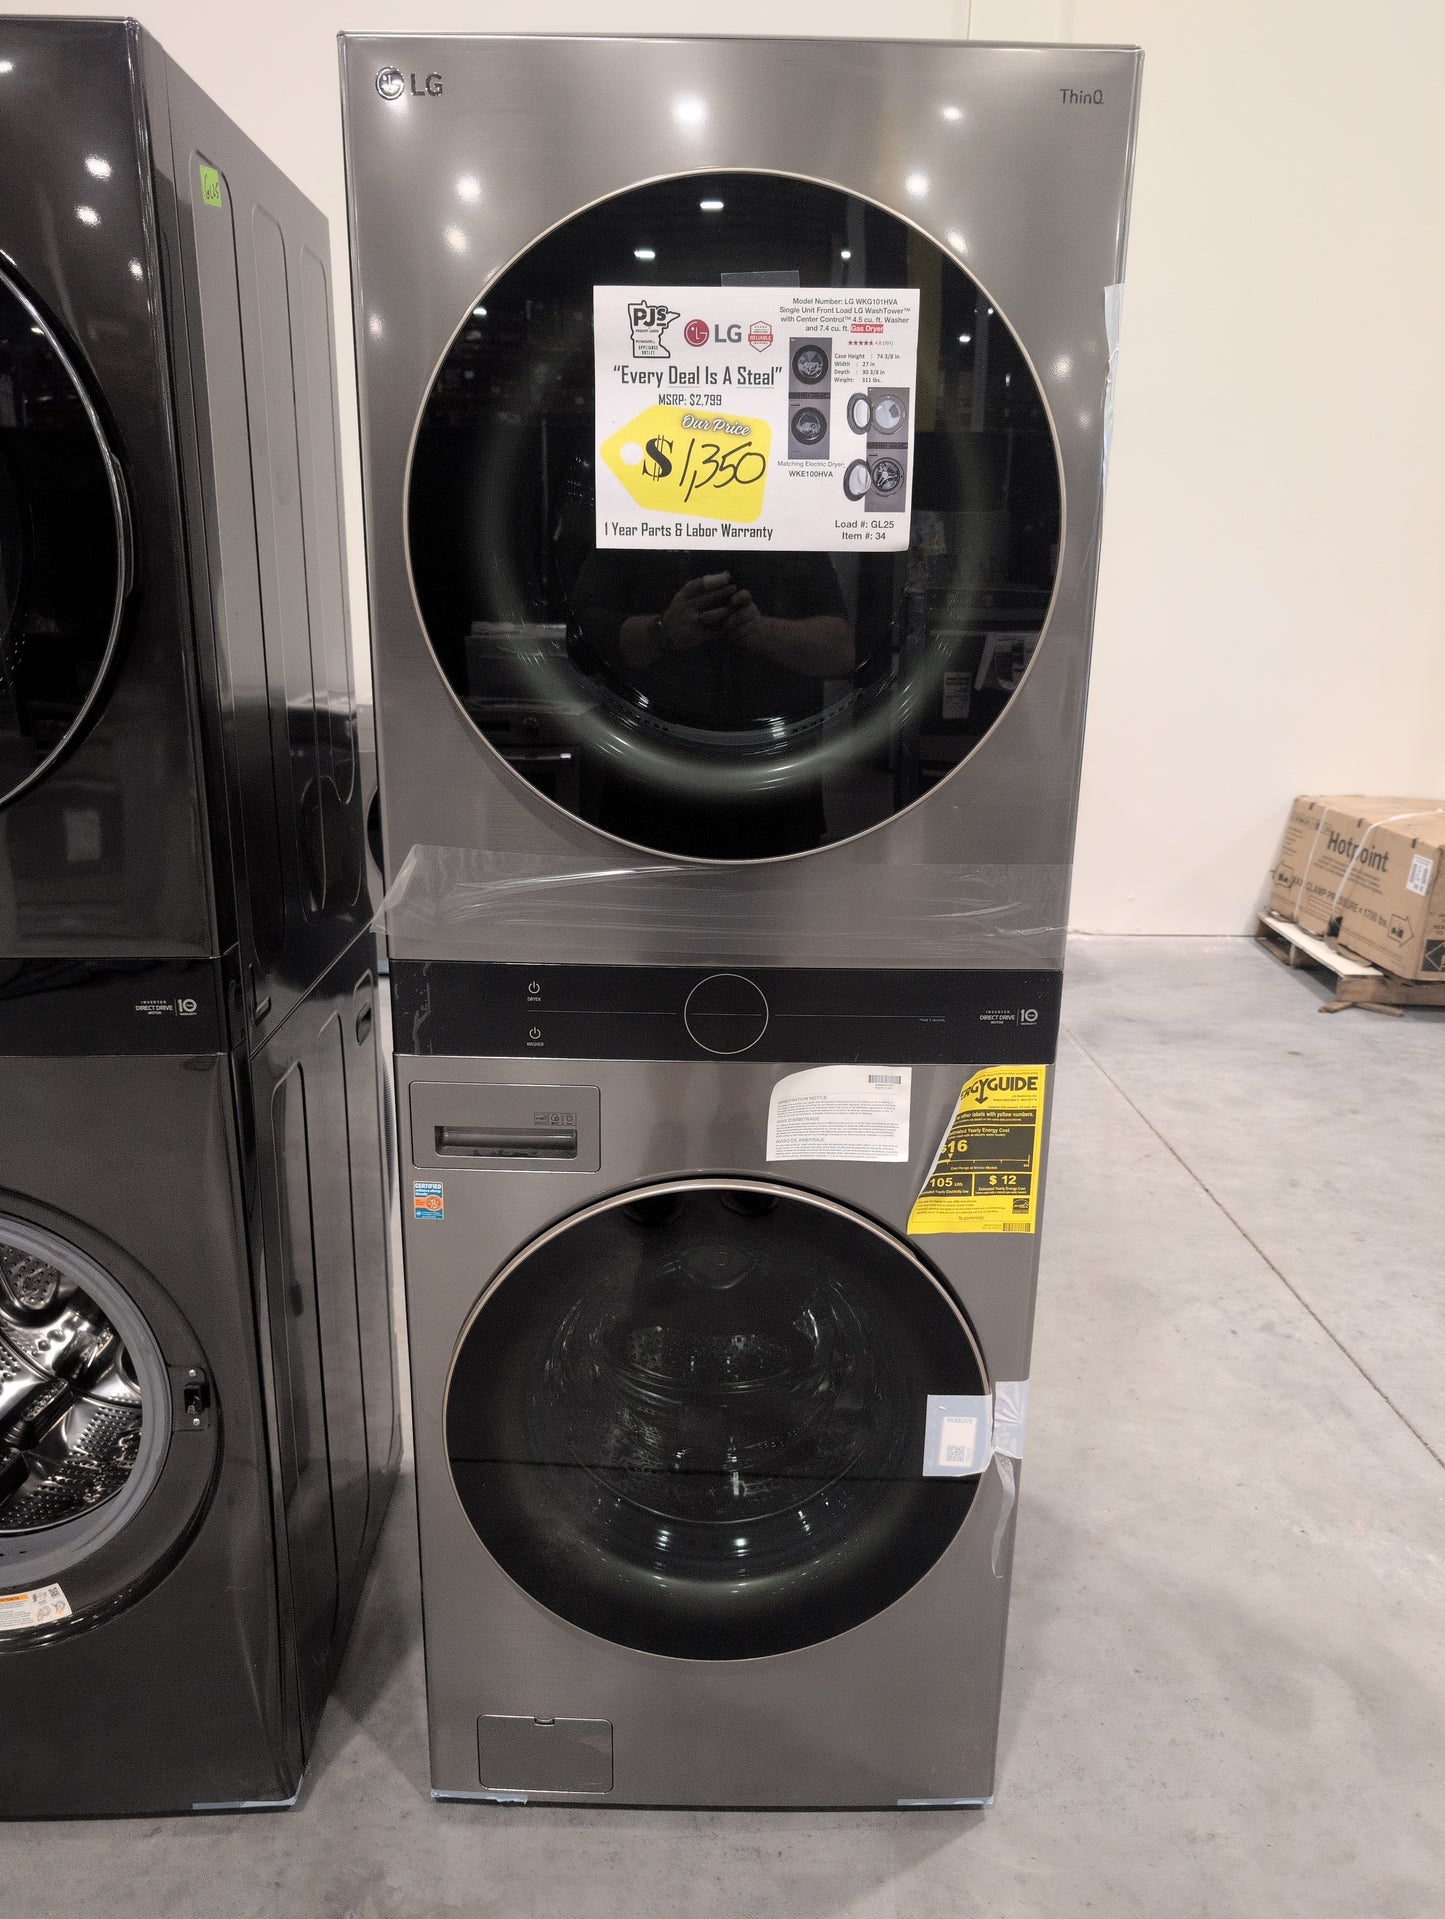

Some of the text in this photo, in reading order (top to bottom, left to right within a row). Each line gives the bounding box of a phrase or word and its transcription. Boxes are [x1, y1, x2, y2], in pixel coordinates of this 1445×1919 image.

[410, 72, 442, 96] LG
[1060, 88, 1104, 104] ThinQ
[714, 324, 742, 343] LG
[668, 366, 700, 384] Deal
[705, 366, 717, 385] Is
[722, 366, 732, 385] A
[658, 394, 722, 406] MSRP: $2,799
[682, 415, 750, 436] Our Price
[605, 522, 773, 540] 1 Year Parts & Labor Warranty
[835, 520, 857, 528] Load
[865, 532, 872, 540] #:
[875, 532, 886, 540] 34
[1327, 830, 1389, 873] Hotpoint
[1328, 890, 1358, 912] PRSSURE
[930, 1177, 953, 1188] 105
[1002, 1175, 1016, 1185] 12
